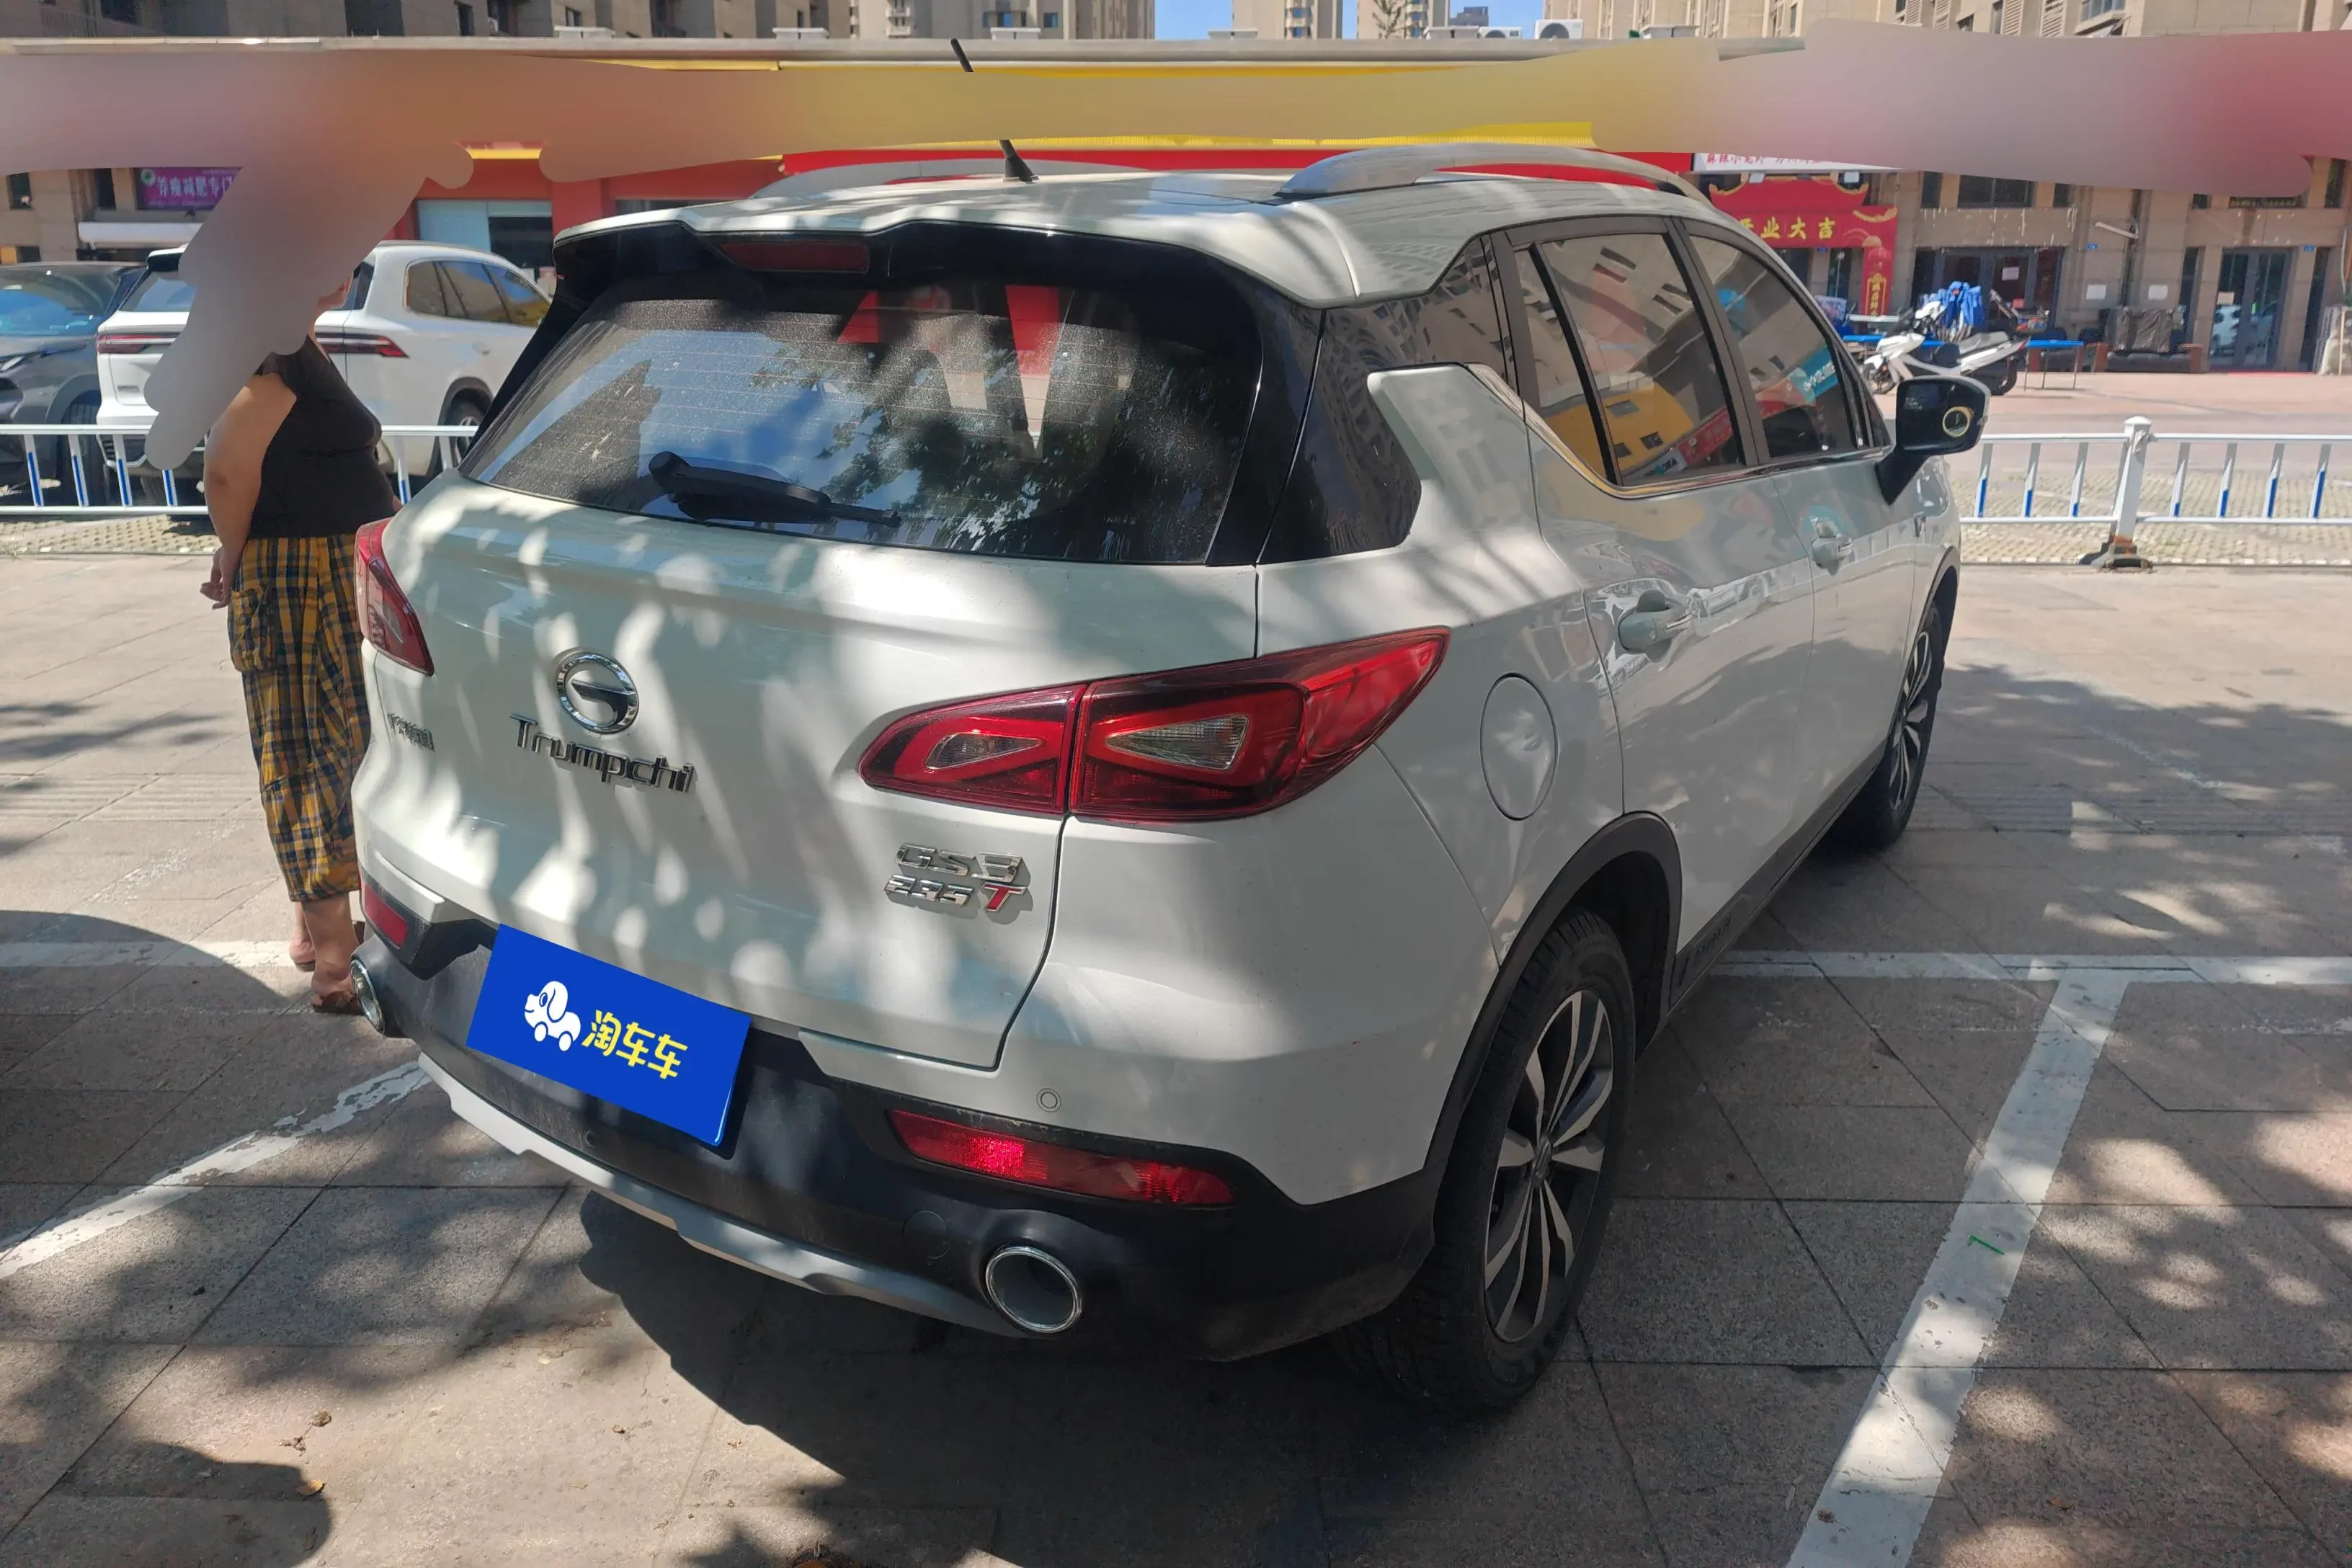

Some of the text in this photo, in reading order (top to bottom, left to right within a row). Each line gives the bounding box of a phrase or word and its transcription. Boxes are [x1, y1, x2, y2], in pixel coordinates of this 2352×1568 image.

[509, 713, 694, 793] Trumpchi
[894, 842, 1023, 883] GS3
[883, 874, 1028, 912] 235T
